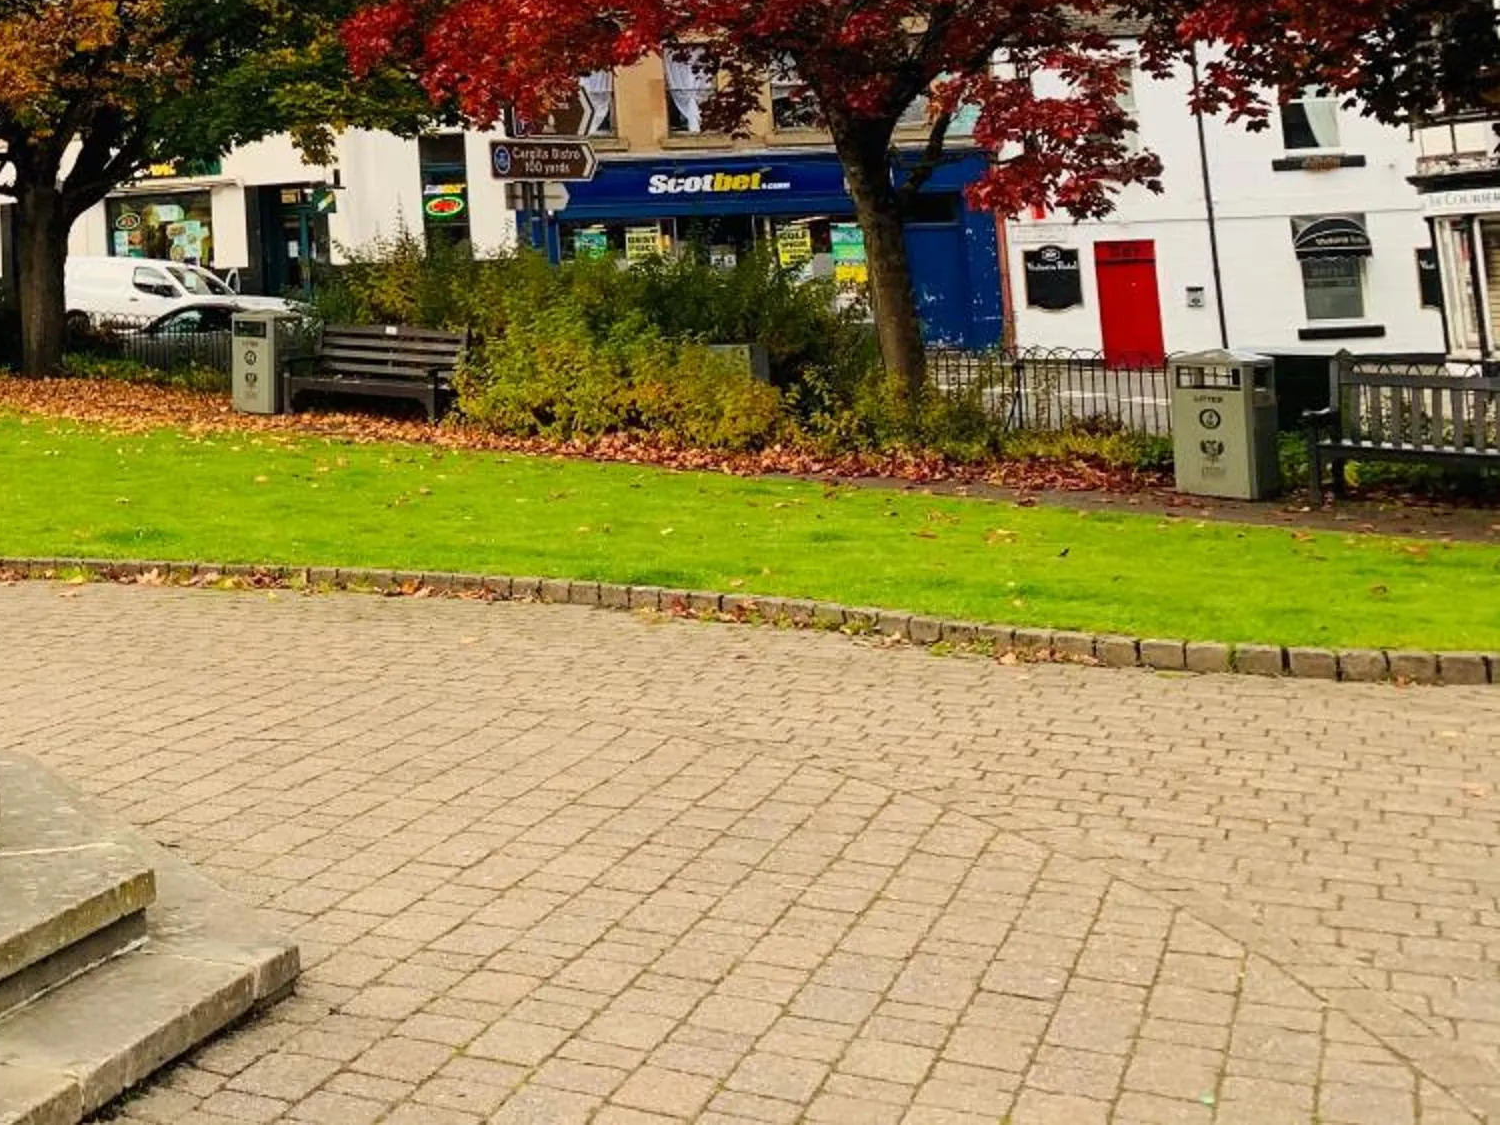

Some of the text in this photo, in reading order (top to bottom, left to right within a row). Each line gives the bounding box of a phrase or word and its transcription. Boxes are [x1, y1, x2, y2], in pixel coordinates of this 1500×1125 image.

[551, 147, 581, 160] Bistro
[525, 162, 571, 175] 100 yards
